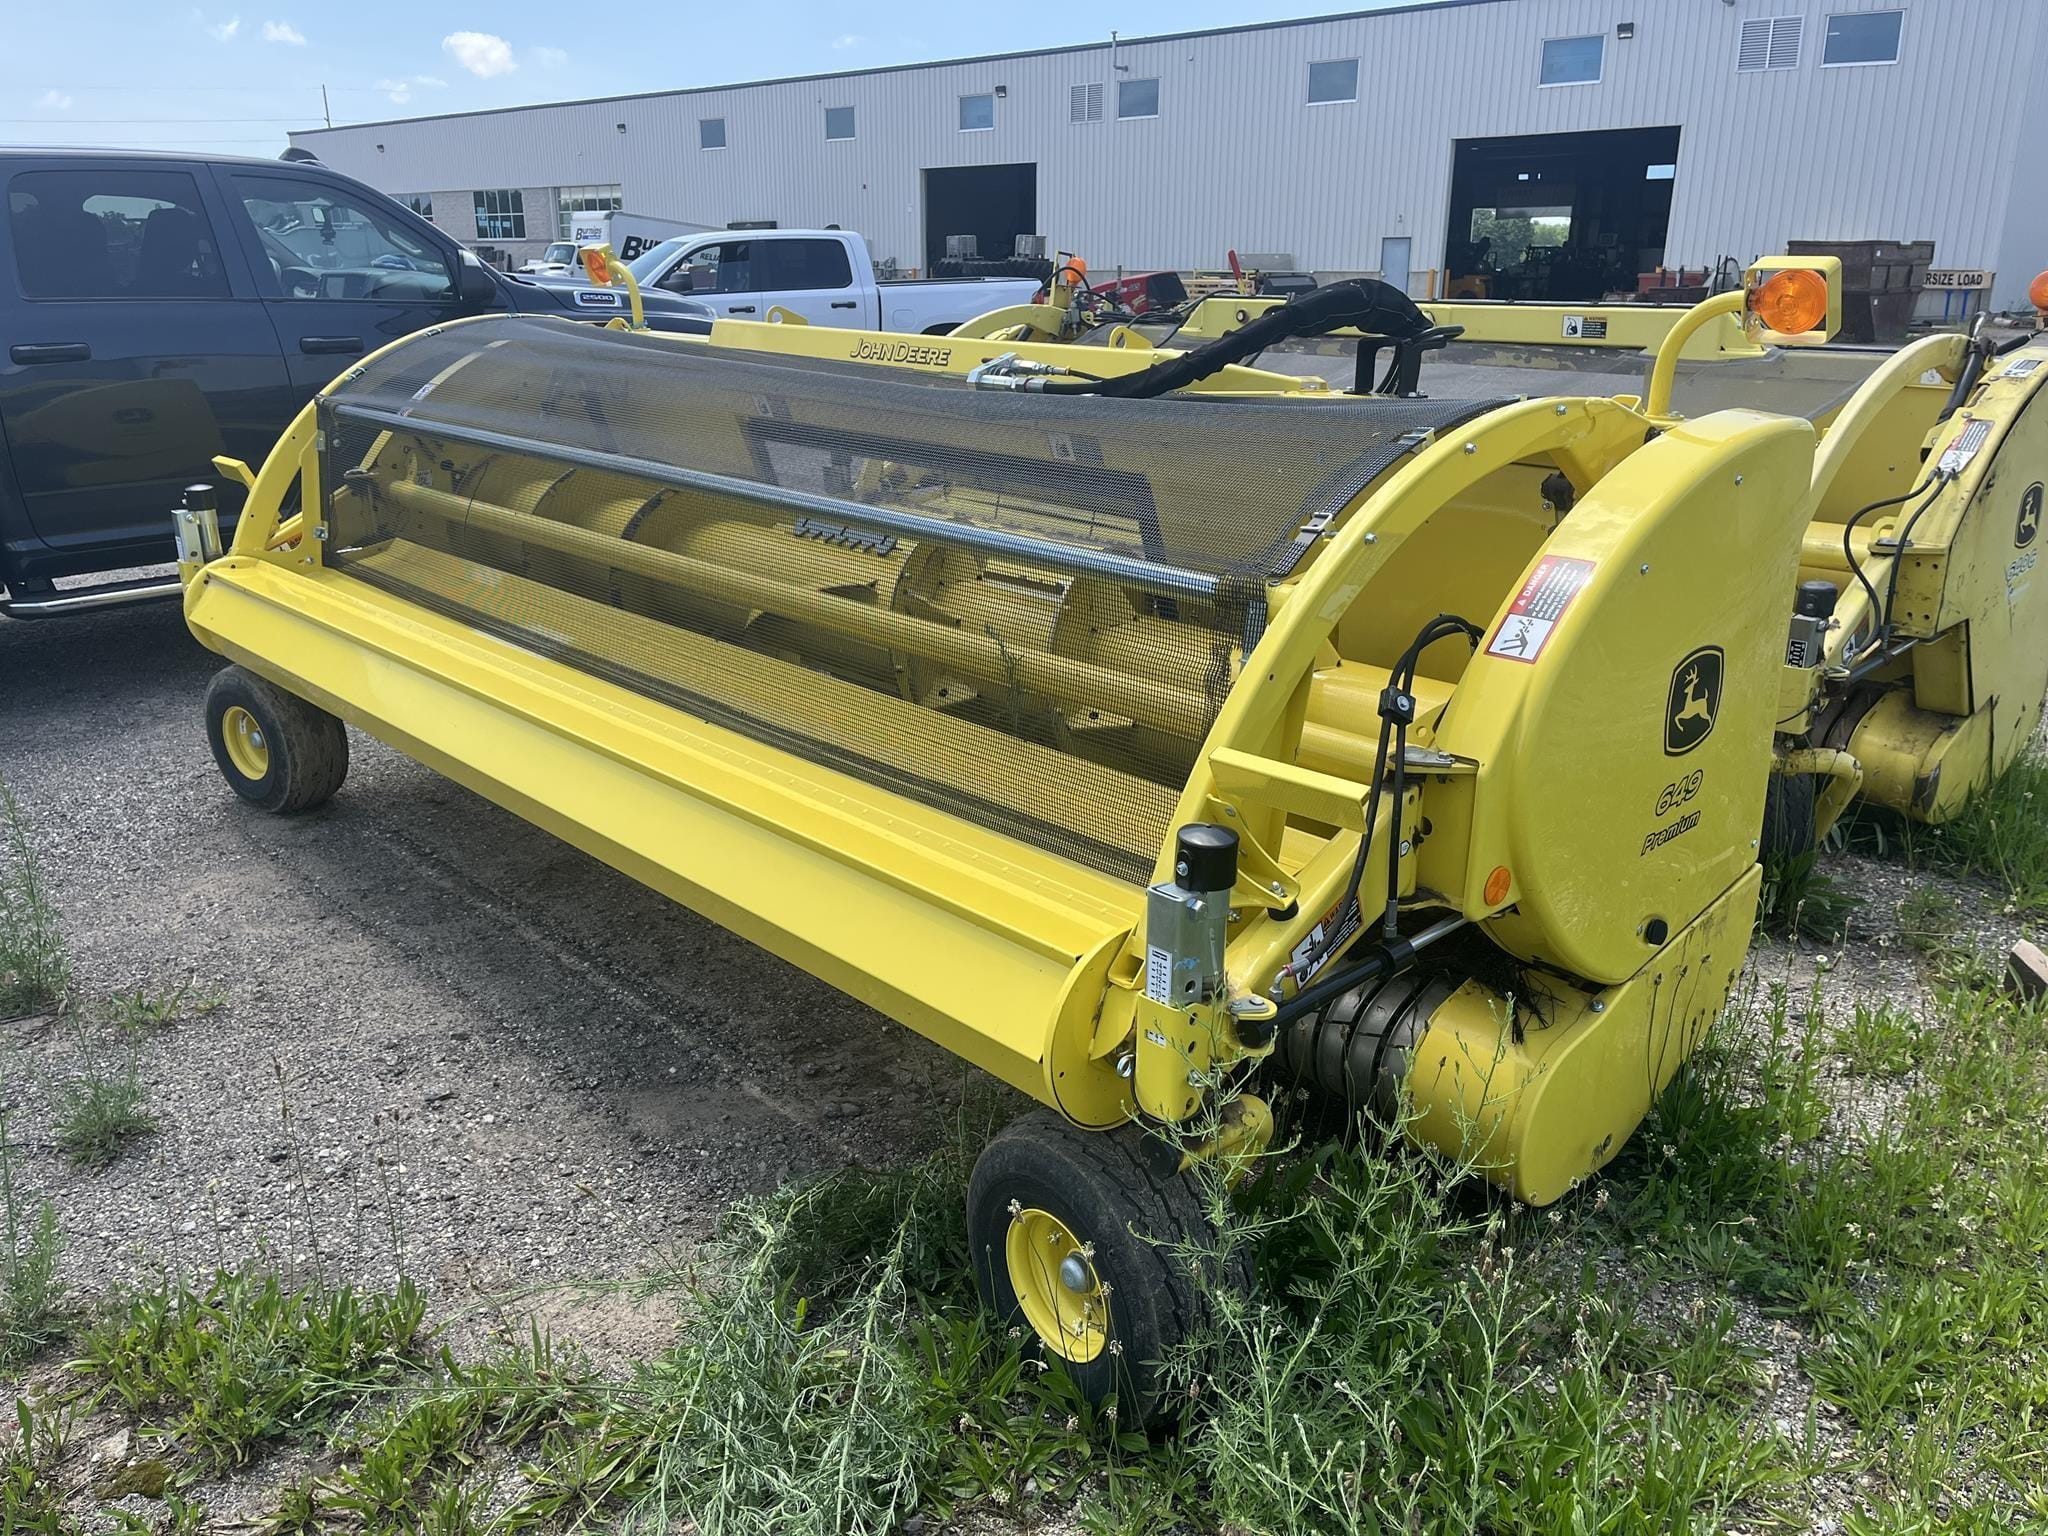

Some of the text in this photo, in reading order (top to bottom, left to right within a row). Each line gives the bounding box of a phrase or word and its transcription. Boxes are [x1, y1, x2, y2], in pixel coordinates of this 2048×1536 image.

[1925, 272, 1983, 287] RSIZE LOAD
[850, 338, 951, 366] JOHN DEERE
[1523, 563, 1550, 597] DANGER
[1655, 768, 1704, 817] 649
[1640, 810, 1702, 857] Premium
